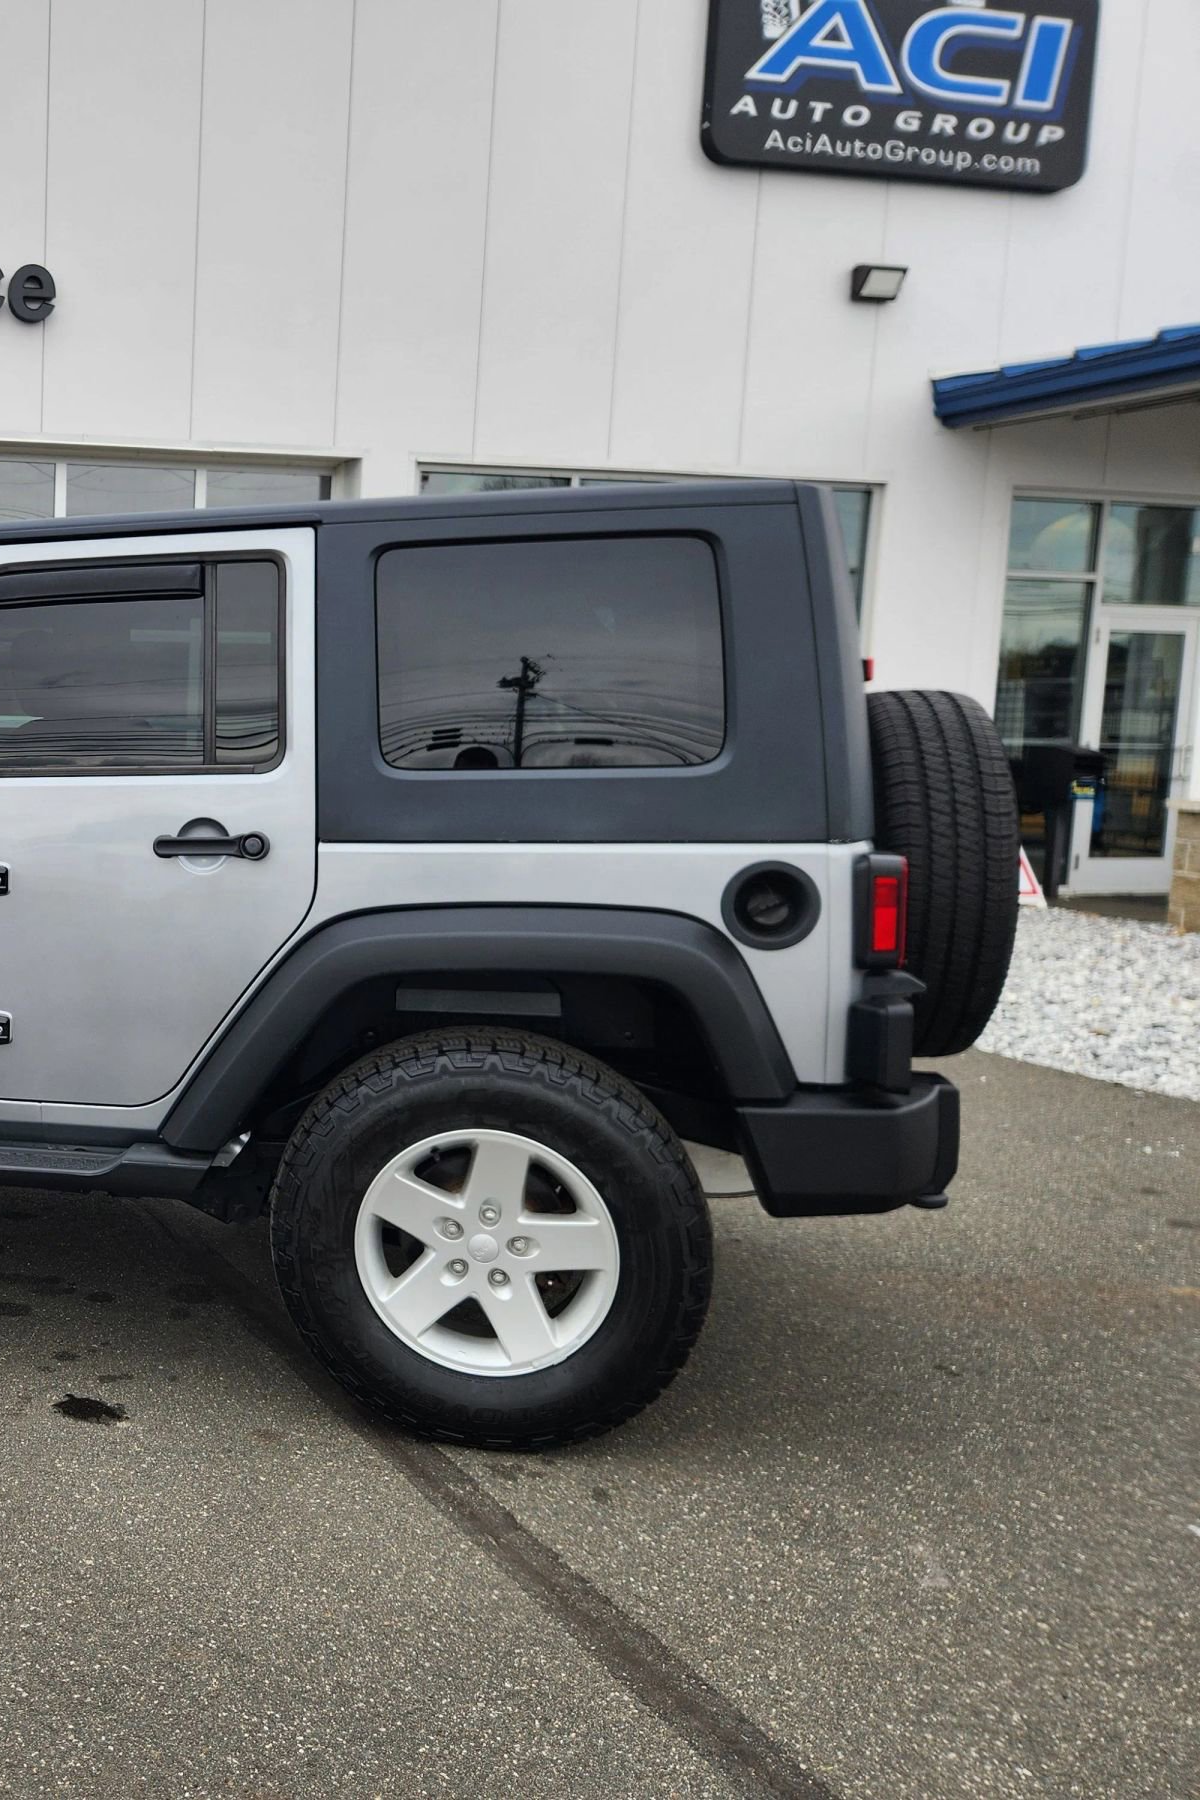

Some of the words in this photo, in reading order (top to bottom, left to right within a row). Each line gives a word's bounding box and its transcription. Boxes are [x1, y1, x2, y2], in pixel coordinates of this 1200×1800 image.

[744, 0, 1074, 112] ACI
[730, 94, 872, 127] AUTO
[894, 110, 1066, 146] GROUP
[764, 129, 1041, 175] AciAutoGroup.com
